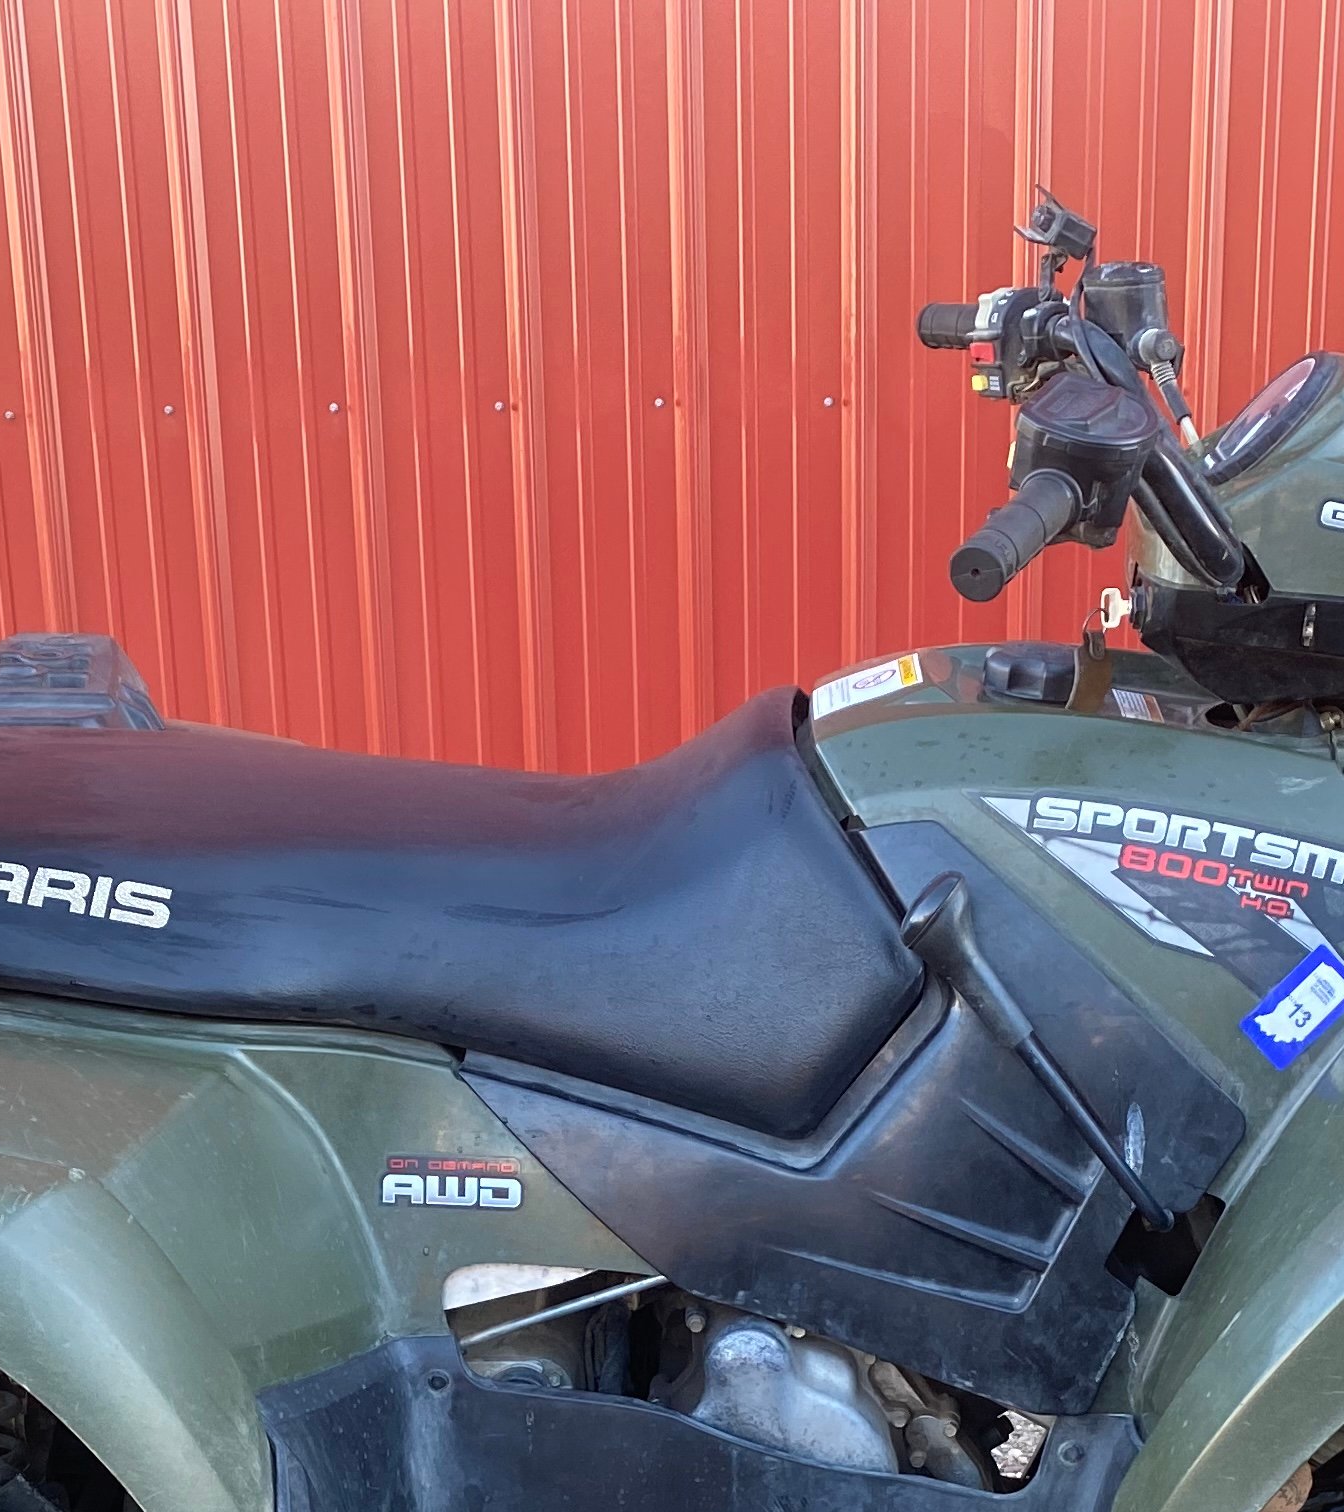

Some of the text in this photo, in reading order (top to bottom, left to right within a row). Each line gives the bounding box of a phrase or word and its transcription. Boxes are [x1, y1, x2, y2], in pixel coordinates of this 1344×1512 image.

[1118, 842, 1311, 899] 800 TWIN
[1288, 1003, 1312, 1028] 13
[389, 1158, 515, 1173] ON DEMAND
[382, 1173, 522, 1208] AWD
